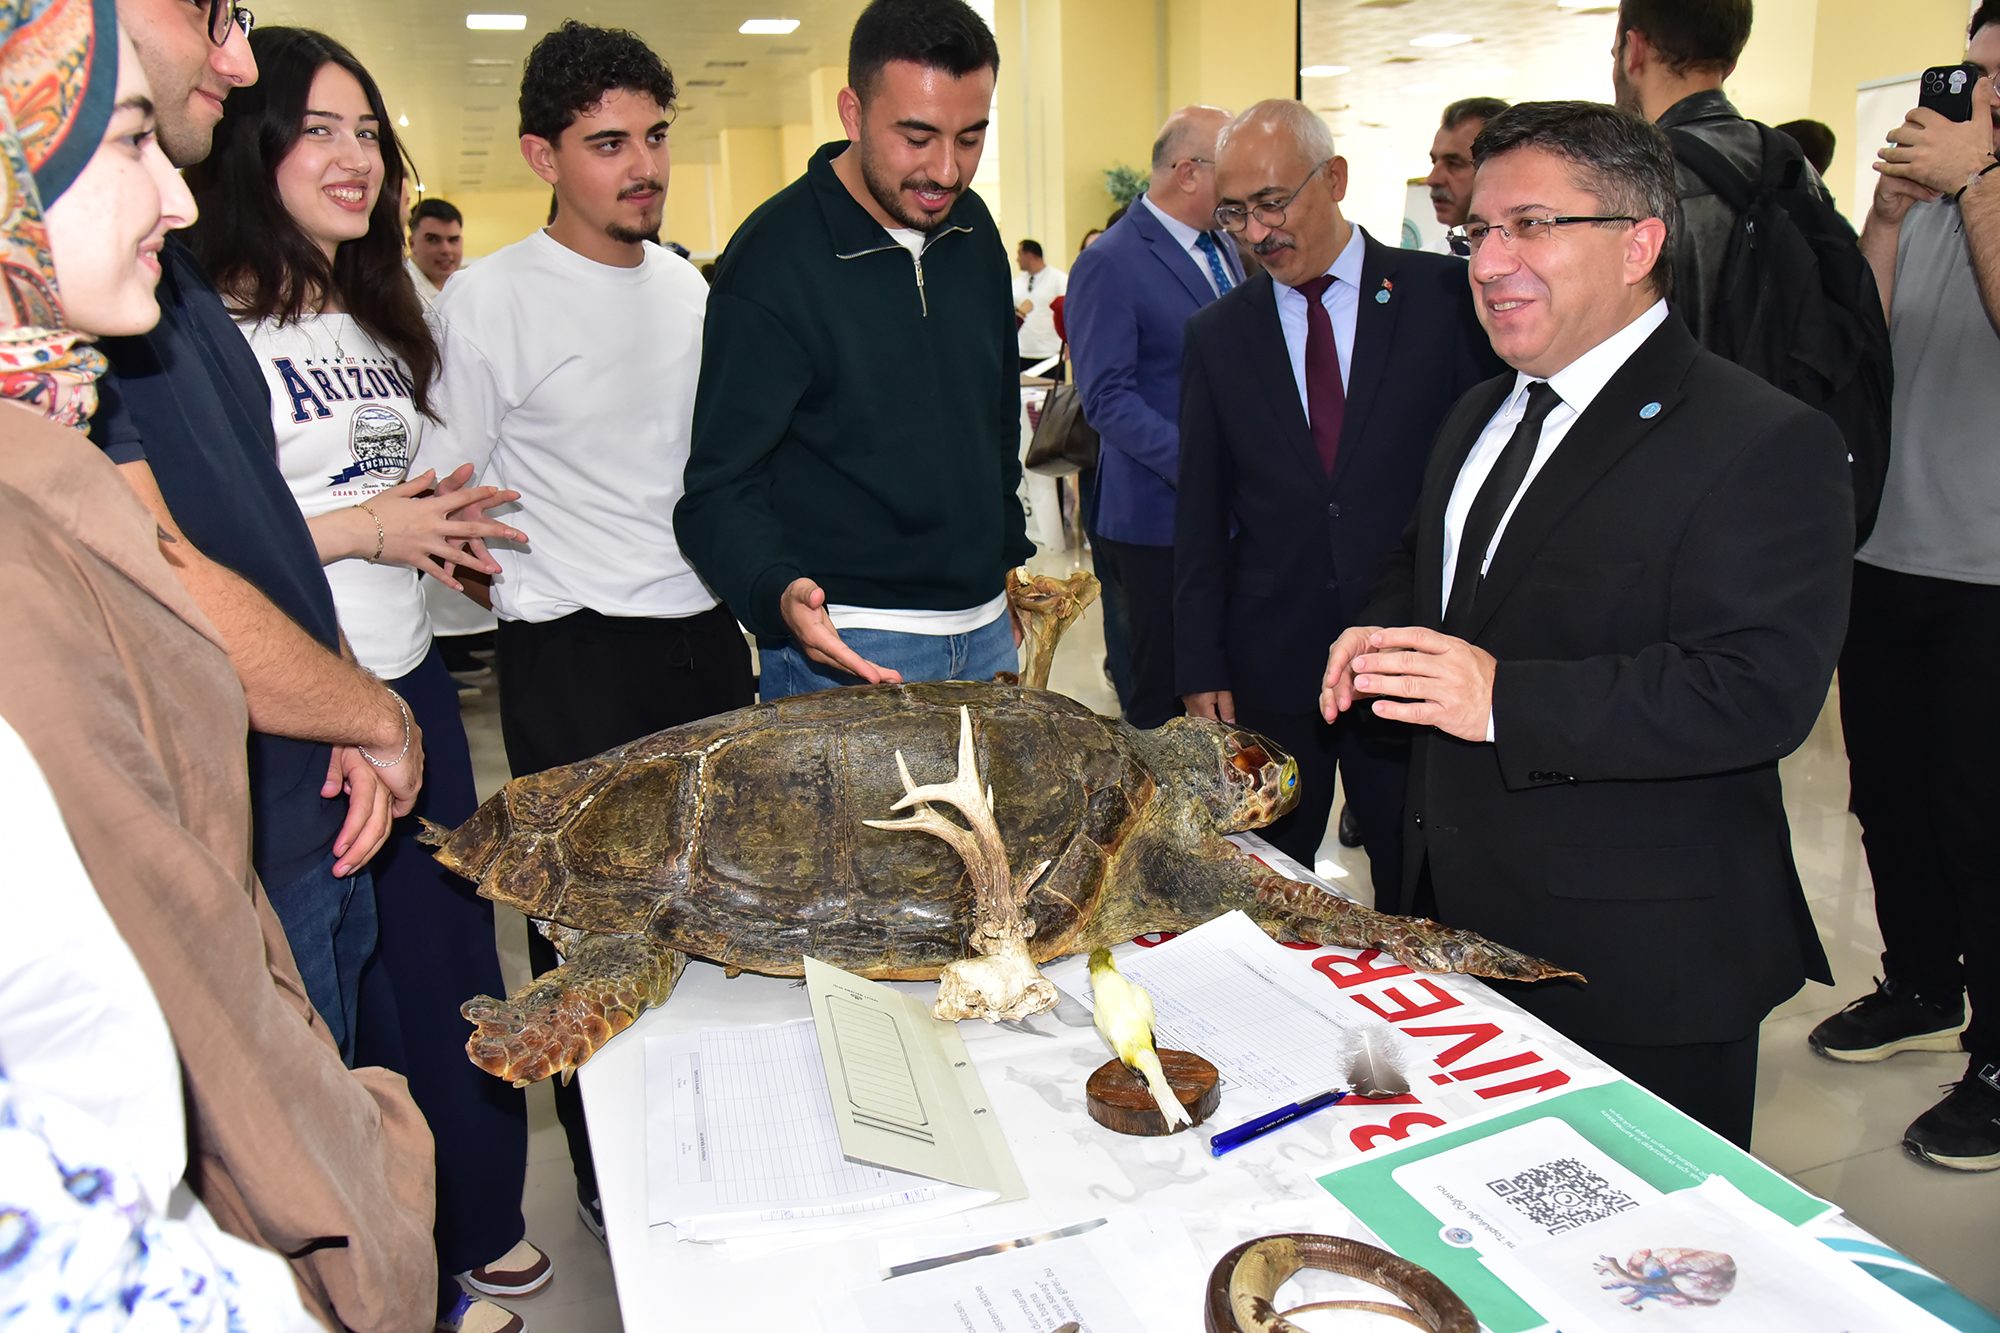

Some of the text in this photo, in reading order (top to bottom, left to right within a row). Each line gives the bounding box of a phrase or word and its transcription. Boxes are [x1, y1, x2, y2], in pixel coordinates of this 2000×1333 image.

[1434, 1184, 1468, 1212] Öğrenci
[1466, 1210, 1506, 1242] Topluluğu
[1043, 1266, 1055, 1278] bu
[975, 1284, 993, 1310] aktive
[1011, 1288, 1042, 1331] durumlarda
